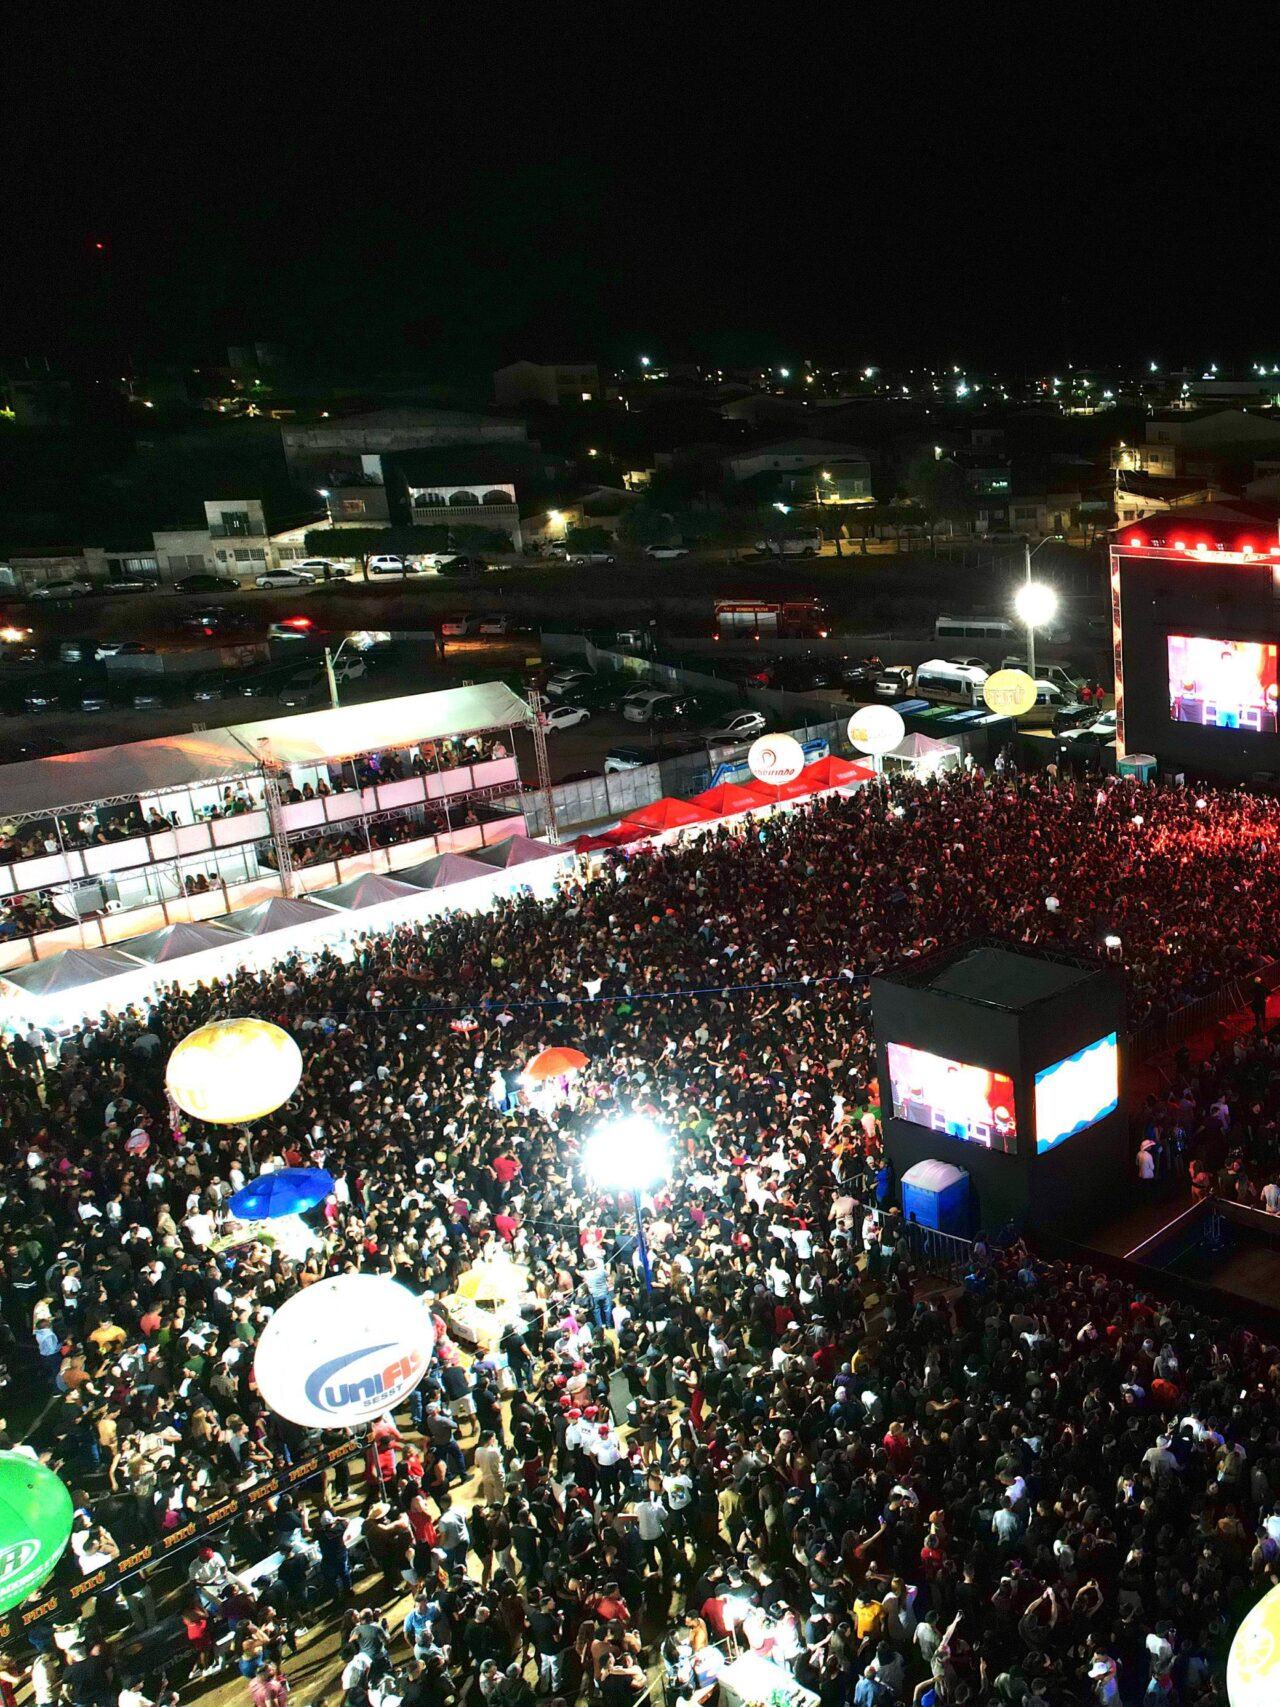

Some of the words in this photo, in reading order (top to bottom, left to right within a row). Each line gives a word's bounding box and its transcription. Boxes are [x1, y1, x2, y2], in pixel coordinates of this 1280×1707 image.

[363, 1383, 403, 1407] SESST
[289, 1457, 318, 1482] PITÚ
[248, 1477, 279, 1503] PITÚ
[207, 1500, 238, 1525] PITÚ
[163, 1521, 196, 1548] PITÚ
[117, 1545, 152, 1573] PITÚ
[69, 1570, 106, 1599] PITÚ
[22, 1596, 58, 1626] PITÚ
